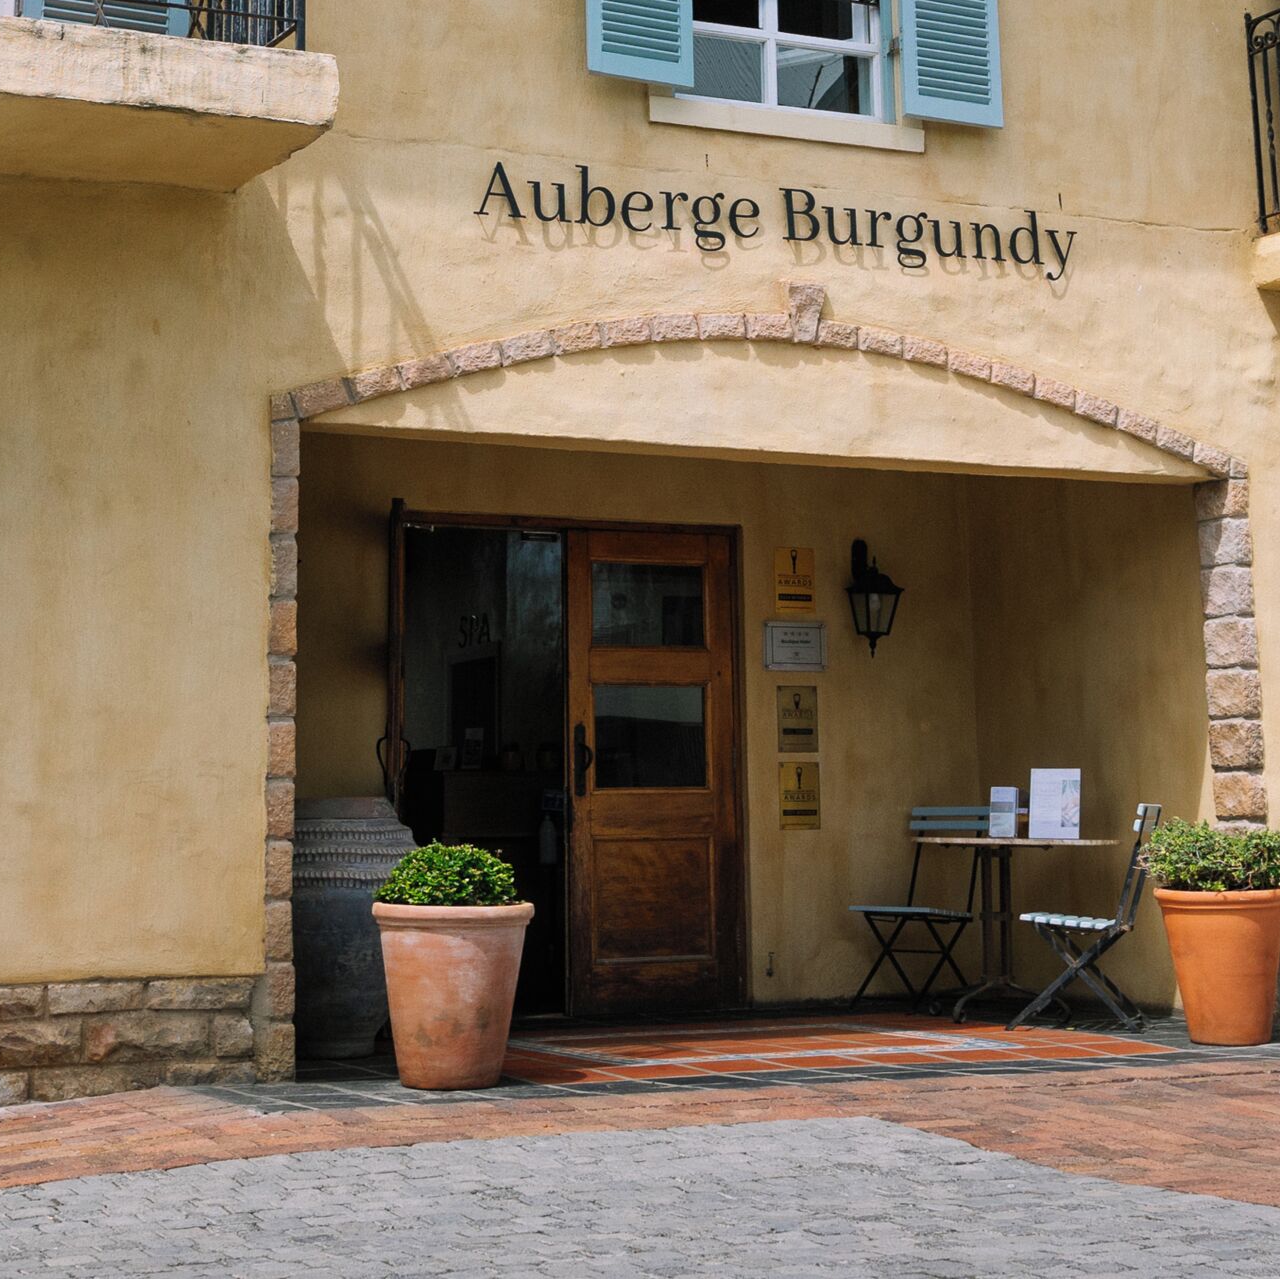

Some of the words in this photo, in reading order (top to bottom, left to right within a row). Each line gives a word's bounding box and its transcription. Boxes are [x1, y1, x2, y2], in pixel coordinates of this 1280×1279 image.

[475, 161, 761, 252] Auberge
[779, 186, 1078, 281] Burgundy
[778, 579, 812, 587] AWARDS
[458, 612, 491, 648] SPA
